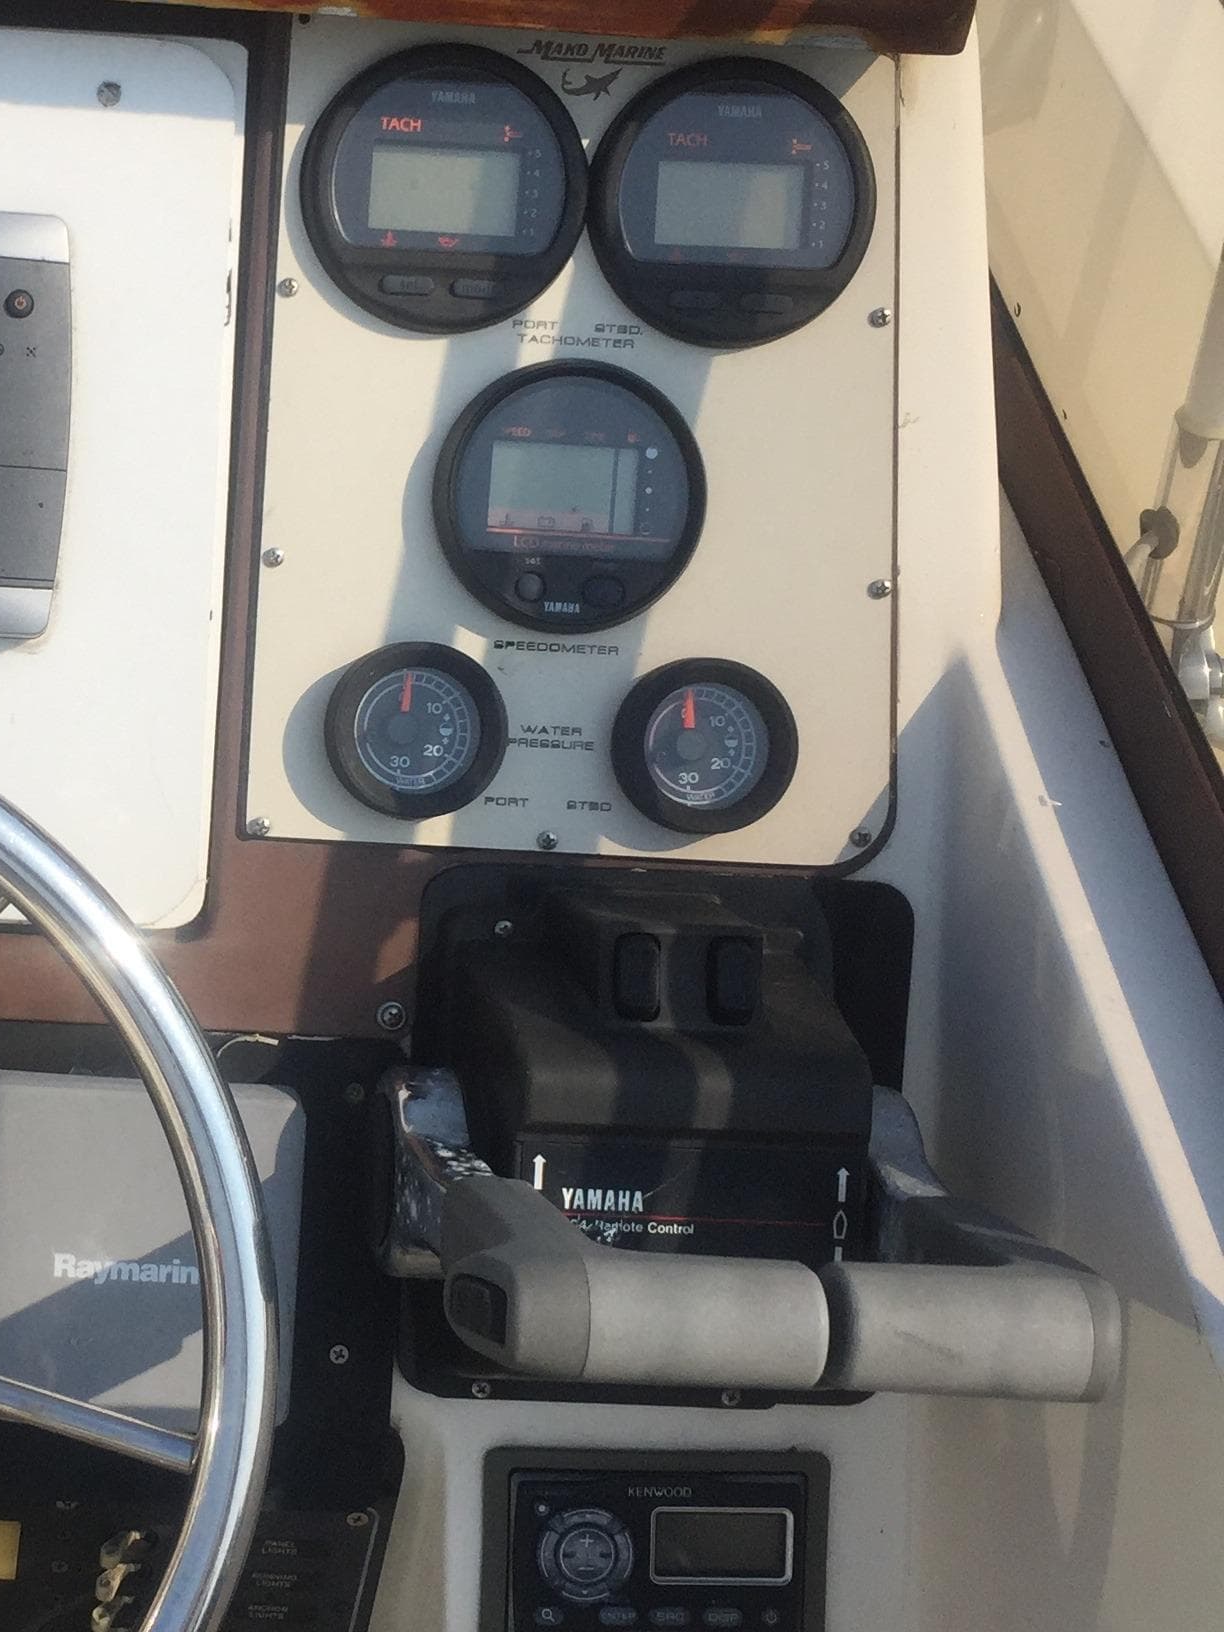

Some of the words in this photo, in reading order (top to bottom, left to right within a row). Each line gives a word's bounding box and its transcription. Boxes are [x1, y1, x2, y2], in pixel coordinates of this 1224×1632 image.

[517, 40, 590, 61] MAKO
[592, 43, 667, 65] MARINE
[431, 91, 475, 104] YAMAHA
[717, 104, 762, 118] YAMAHA
[380, 116, 422, 132] TACH
[666, 132, 708, 147] TACH
[511, 319, 559, 332] PORT
[517, 333, 635, 349] TACHOMETER
[543, 601, 581, 614] YAMAHA
[493, 639, 620, 656] SPEEDOMETER
[426, 702, 443, 714] 10
[710, 715, 726, 727] 10
[520, 724, 583, 737] WATER
[423, 744, 444, 757] 20
[390, 755, 411, 768] 30
[710, 757, 731, 770] 20
[678, 771, 699, 785] 30
[484, 796, 529, 808] PORT
[561, 1186, 644, 1212] YAMAHA
[647, 1221, 695, 1235] Control
[52, 1251, 201, 1286] Raymarin
[627, 1486, 693, 1498] KENWOOD
